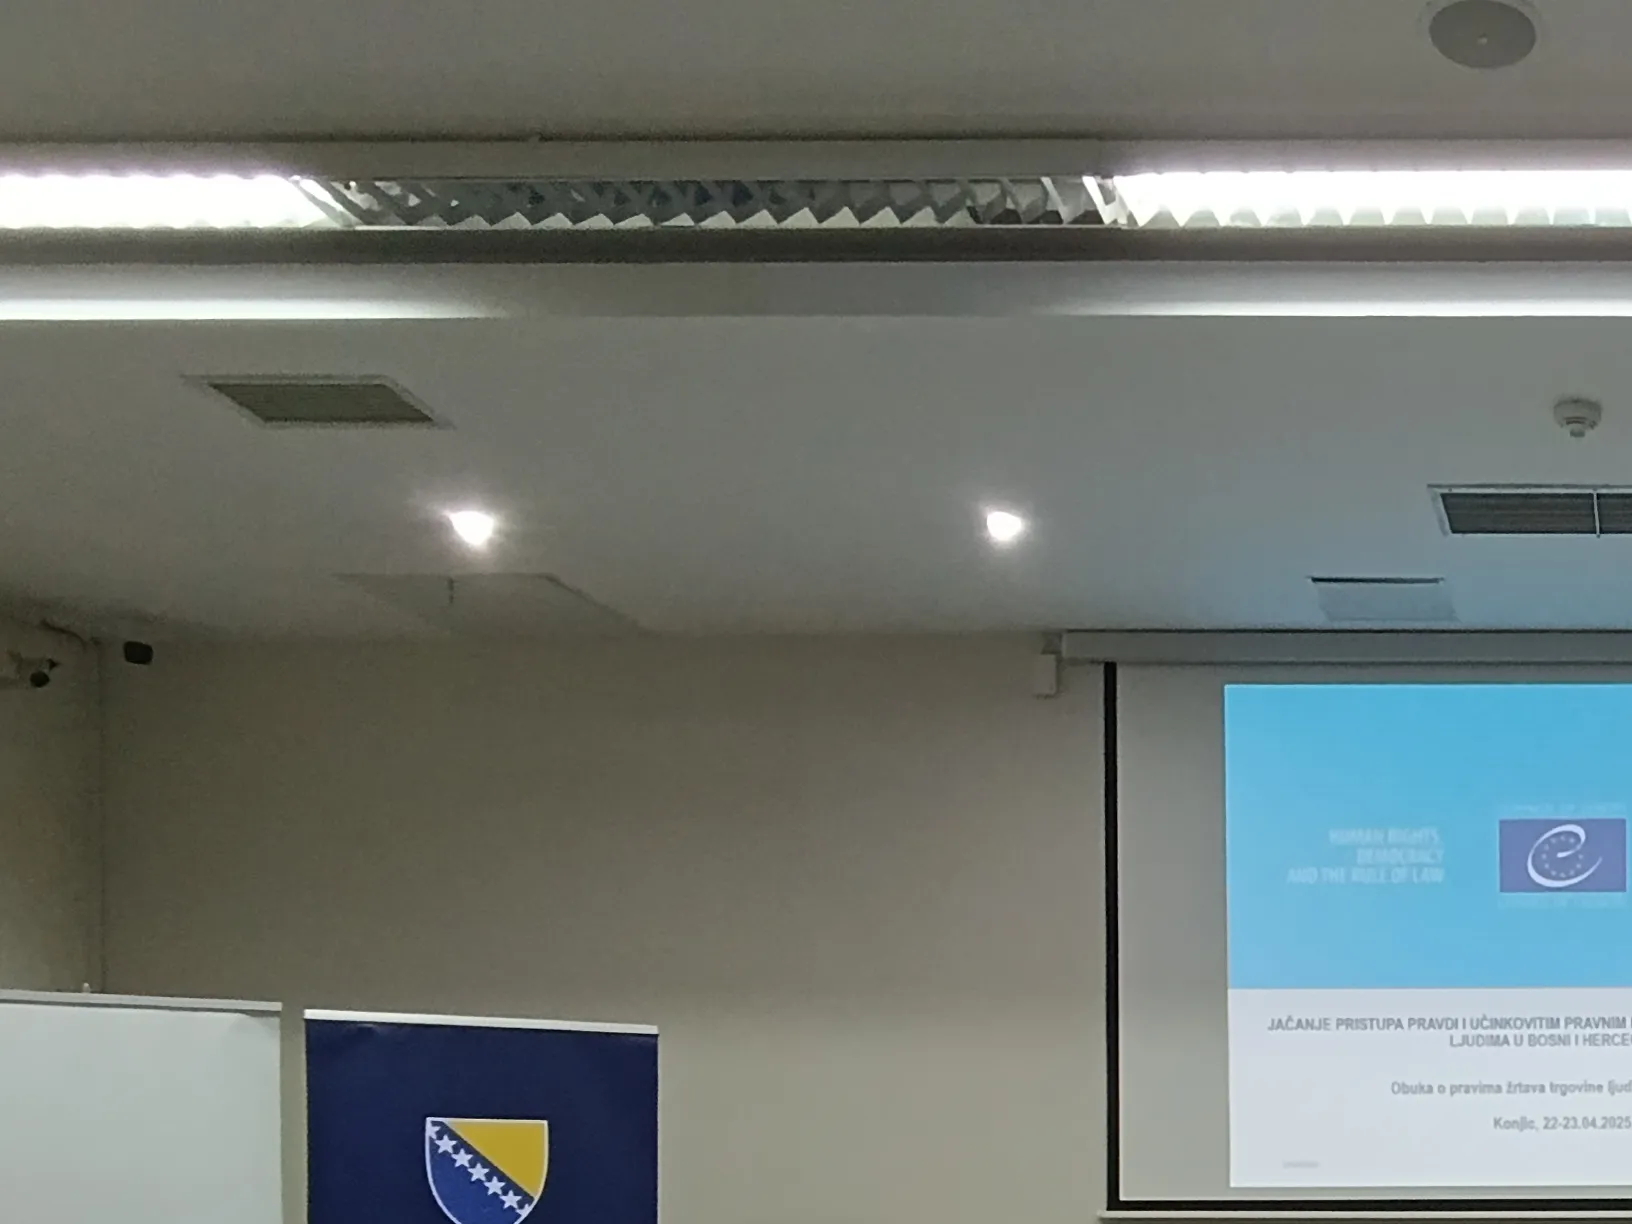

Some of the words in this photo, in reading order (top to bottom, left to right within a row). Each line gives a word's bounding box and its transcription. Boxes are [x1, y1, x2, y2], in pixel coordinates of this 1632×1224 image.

[1268, 1015, 1331, 1031] JAČANJE
[1336, 1017, 1404, 1031] PRISTUPA
[1407, 1017, 1459, 1030] PRAVDI
[1469, 1013, 1561, 1030] UČINKOVITIM
[1564, 1016, 1626, 1029] PRAVNIM
[1450, 1034, 1510, 1047] LJUDIMA
[1514, 1034, 1523, 1047] U
[1528, 1033, 1570, 1046] BOSNI
[1391, 1081, 1434, 1095] Obuka
[1438, 1085, 1446, 1095] o
[1450, 1081, 1501, 1098] pravima
[1506, 1081, 1545, 1095] žrtava
[1549, 1080, 1603, 1097] trgovine
[1543, 1116, 1632, 1130] 22-23.04.2025
